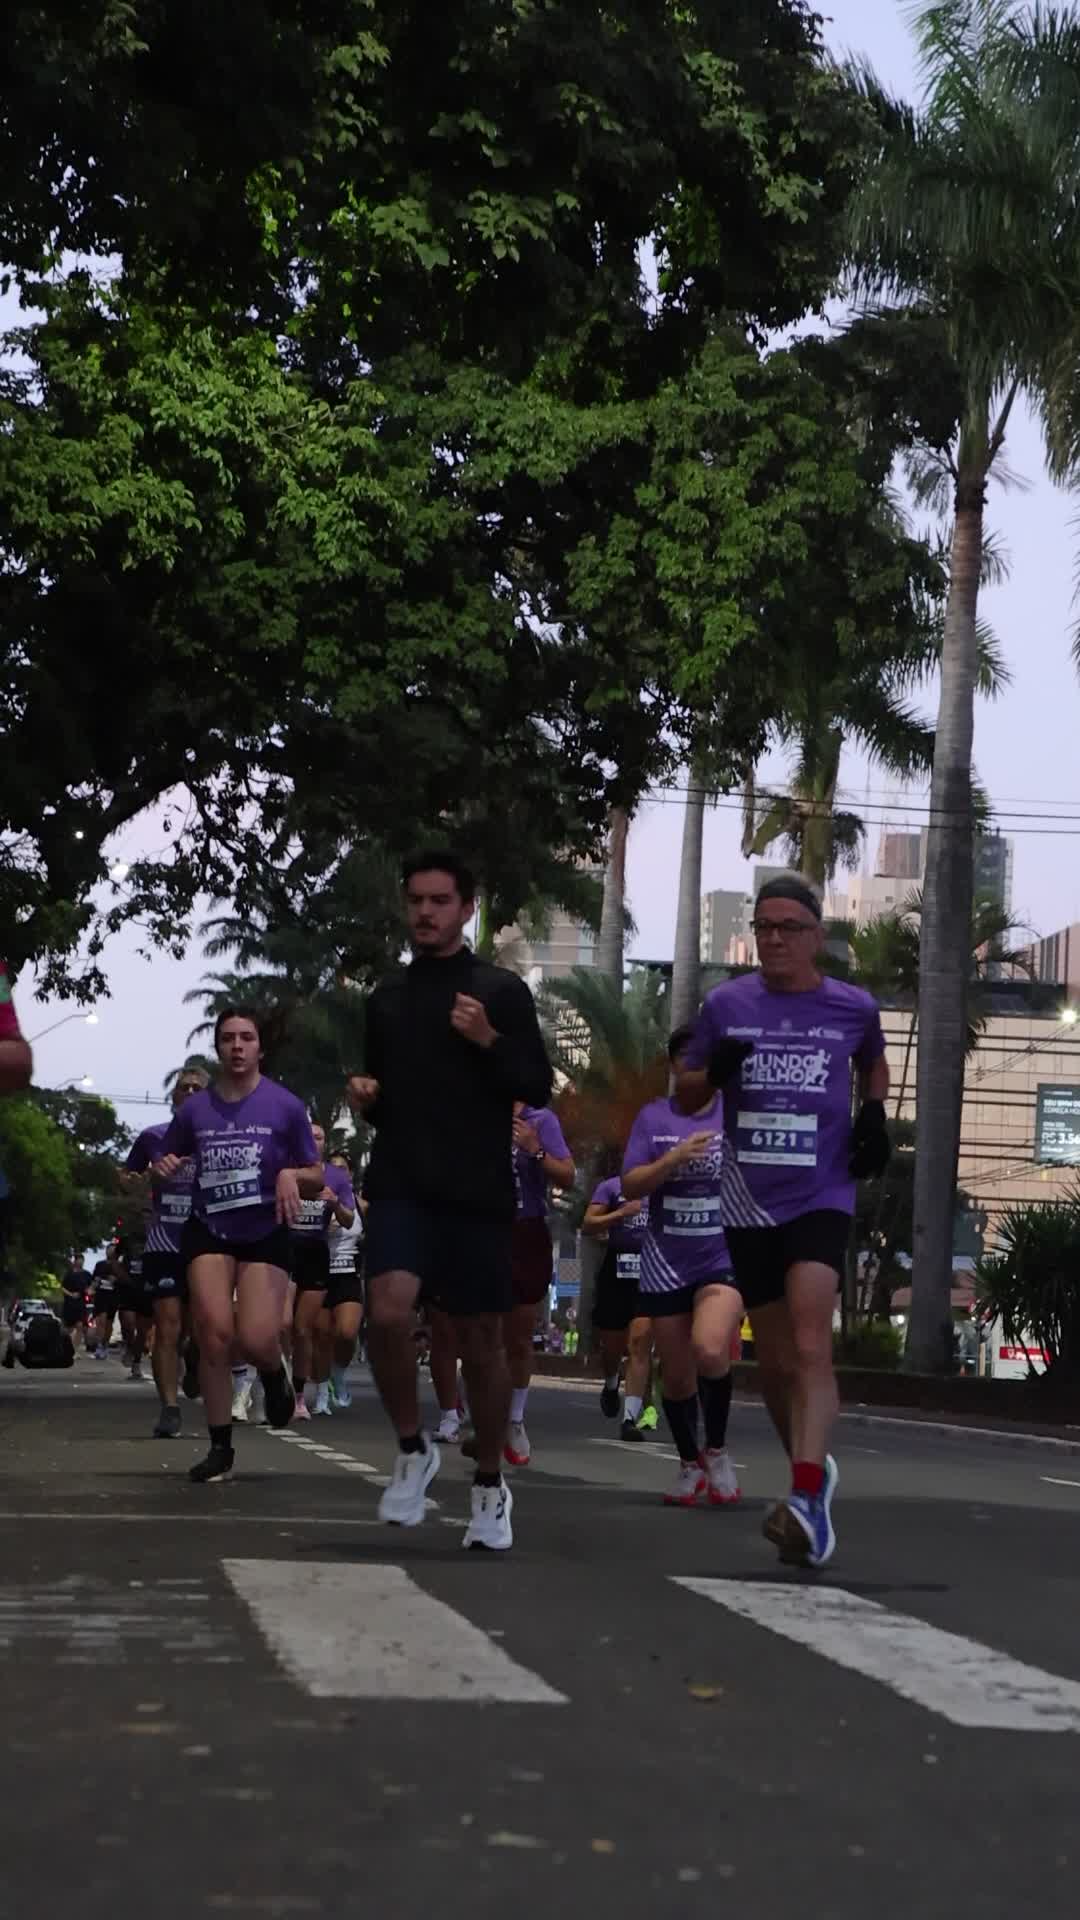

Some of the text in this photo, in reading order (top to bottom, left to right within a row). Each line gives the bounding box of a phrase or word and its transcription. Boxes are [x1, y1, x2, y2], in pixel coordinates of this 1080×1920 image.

[742, 1053, 818, 1070] MUNDO
[751, 1131, 797, 1147] 6121
[214, 1182, 246, 1199] 5115
